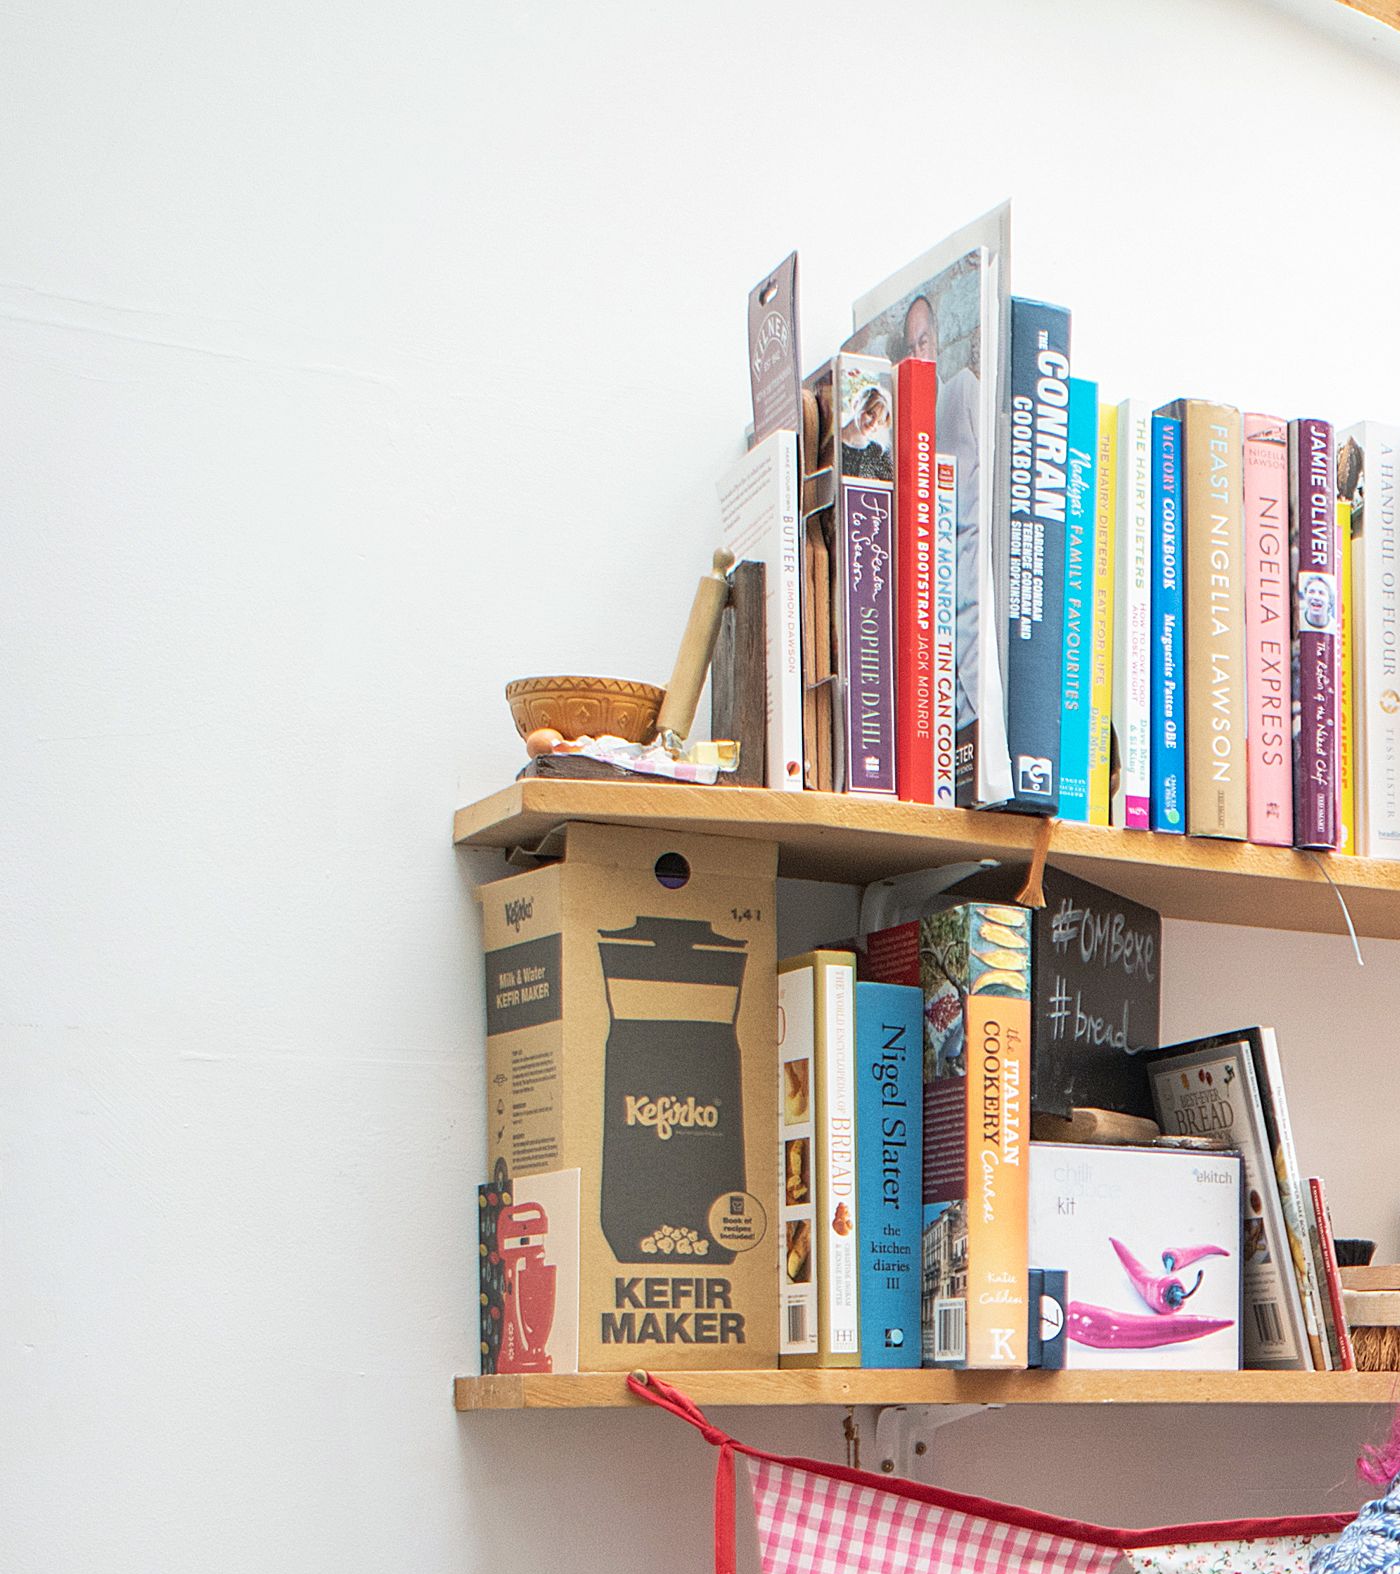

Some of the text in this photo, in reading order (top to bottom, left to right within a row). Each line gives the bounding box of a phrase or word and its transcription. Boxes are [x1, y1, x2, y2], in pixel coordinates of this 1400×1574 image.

[754, 317, 790, 374] KILNER
[1011, 396, 1033, 514] COOKBOOK
[1035, 330, 1069, 522] THE CONRAN
[1209, 424, 1229, 504] FEAST
[783, 515, 794, 573] BUTTER
[1096, 434, 1110, 577] THE HAIRY DIETERS
[1134, 418, 1146, 589] THE HAIRY DIETERS
[1310, 425, 1329, 566] JAMIE OLIVER
[917, 432, 930, 739] COOKING ON A BOOTSTRAP JACK MONROE
[1010, 520, 1021, 619] SIMON HOPKINSON
[1020, 522, 1033, 640] TERENCE CONRAN AND
[1033, 524, 1044, 622] CAROLINE CONRAN
[1065, 447, 1091, 712] Nadiya's FAMILY FAVOURITES
[1161, 425, 1177, 749] VICTORY COOKBOOK Marguerite Patten OBE
[1209, 514, 1231, 637] NIGELLA
[1380, 464, 1397, 677] HANDFUL OF FLOUR
[860, 606, 881, 749] SOPHIE DAHL
[937, 494, 953, 780] JACK MONROE TIN CAN COOK
[1259, 496, 1282, 767] NIGELLA EXPRESS
[1211, 653, 1231, 783] LAWSON
[731, 907, 753, 922] 1,4
[1051, 898, 1155, 984] #OMBexe
[496, 983, 550, 1009] KEFIR MAKER
[499, 964, 546, 988] Milk & Water
[1047, 974, 1145, 1055] #bread
[831, 971, 852, 1197] THE WORLD ENCYCLOPEDIA OF BREAD
[871, 1022, 908, 1108] Nigel
[1003, 1026, 1022, 1166] the ITALIAN
[624, 1095, 720, 1140] Kefirko
[881, 1116, 908, 1210] Slater
[980, 1020, 1001, 1224] COOKERY Course
[1175, 1100, 1234, 1135] BREAD
[870, 1240, 912, 1257] kitchen
[882, 1225, 900, 1237] the
[1057, 1197, 1076, 1215] kit
[615, 1277, 732, 1309] KEFIR
[873, 1258, 911, 1273] diaries
[886, 1277, 900, 1290] III
[601, 1313, 747, 1344] MAKER
